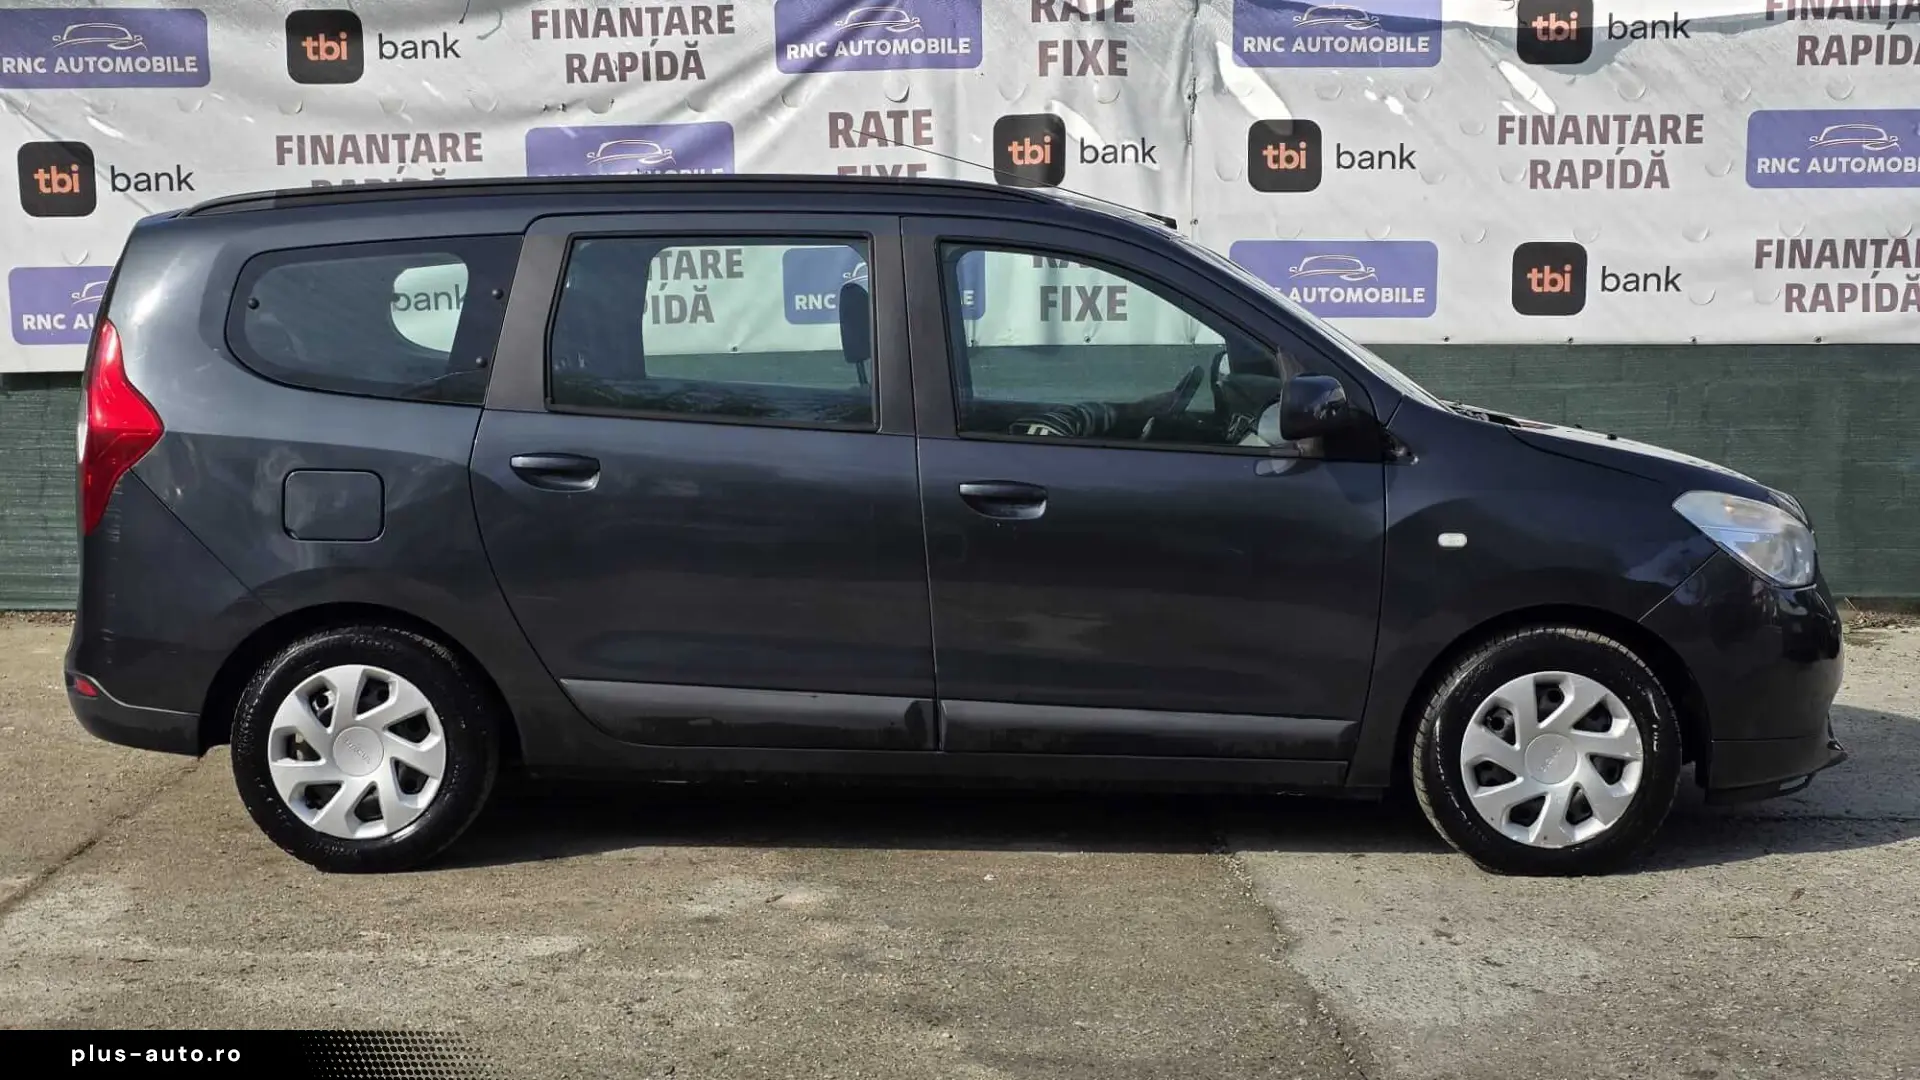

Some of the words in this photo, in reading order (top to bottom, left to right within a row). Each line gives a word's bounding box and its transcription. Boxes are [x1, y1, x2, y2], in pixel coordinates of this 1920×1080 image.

[1532, 10, 1578, 42] tbi
[1607, 12, 1691, 41] bank
[301, 31, 347, 61] tbi
[377, 32, 461, 60] bank
[786, 43, 828, 61] RNC
[834, 37, 971, 56] AUTOMOBILE
[1038, 38, 1128, 77] FIXE
[1243, 36, 1286, 54] RNC
[1291, 36, 1430, 54] AUTOMOBILE
[1796, 33, 1920, 67] RAPID
[2, 57, 47, 75] RNC
[54, 55, 199, 74] AUTOMOBILE
[828, 108, 934, 149] RATE
[1007, 135, 1052, 166] tbi
[1079, 137, 1157, 165] bank
[1262, 142, 1307, 170] tbi
[1336, 143, 1417, 170] bank
[34, 164, 80, 194] tbi
[110, 165, 195, 193] bank
[1757, 157, 1801, 174] RNC
[1527, 264, 1571, 293] tbi
[1600, 266, 1682, 293] bank
[795, 293, 837, 311] RNC
[1040, 285, 1128, 322] FIXE
[1288, 286, 1426, 304] AUTOMOBILE
[22, 313, 67, 331] RNC
